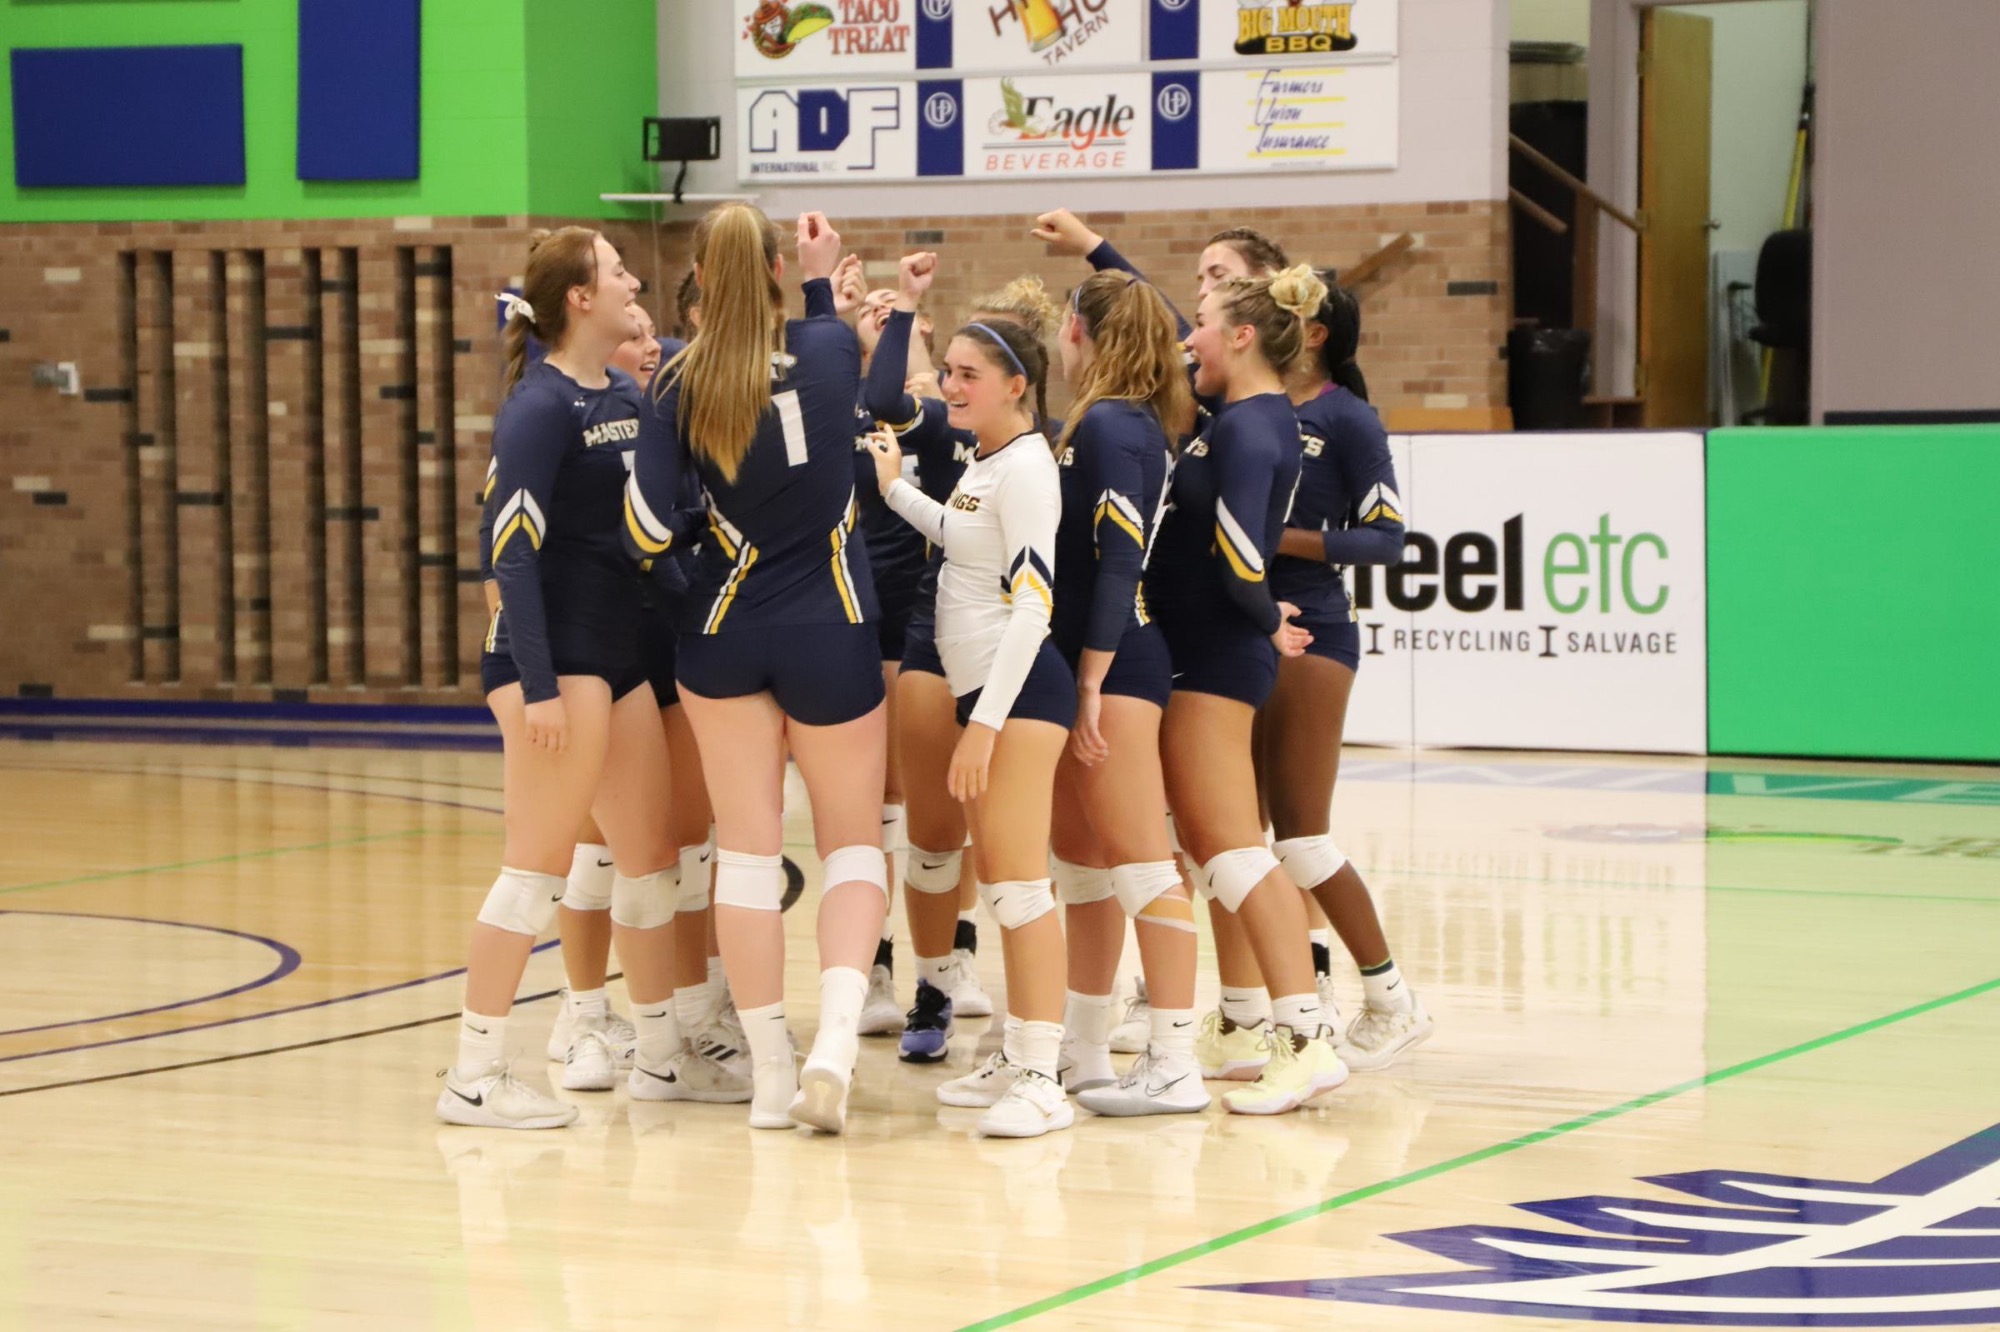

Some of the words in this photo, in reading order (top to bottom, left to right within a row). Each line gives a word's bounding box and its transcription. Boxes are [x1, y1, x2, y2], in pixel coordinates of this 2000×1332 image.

[839, 0, 899, 24] TACO
[1238, 8, 1273, 44] BIG
[1277, 3, 1352, 41] MOUTH
[828, 25, 910, 55] TREAT
[1042, 10, 1109, 65] TAVERN
[1265, 35, 1332, 53] BBQ
[1257, 69, 1324, 98] Farmers
[1017, 94, 1135, 151] Eagle
[1255, 97, 1303, 126] Union
[750, 87, 900, 170] ADF
[1256, 123, 1331, 153] Insurance
[751, 162, 819, 174] INTERNATIONAL
[985, 151, 1127, 171] BEVERAGE
[1543, 512, 1669, 615] etc
[1394, 629, 1531, 652] RECYCLING
[1567, 632, 1678, 654] SALVAGE
